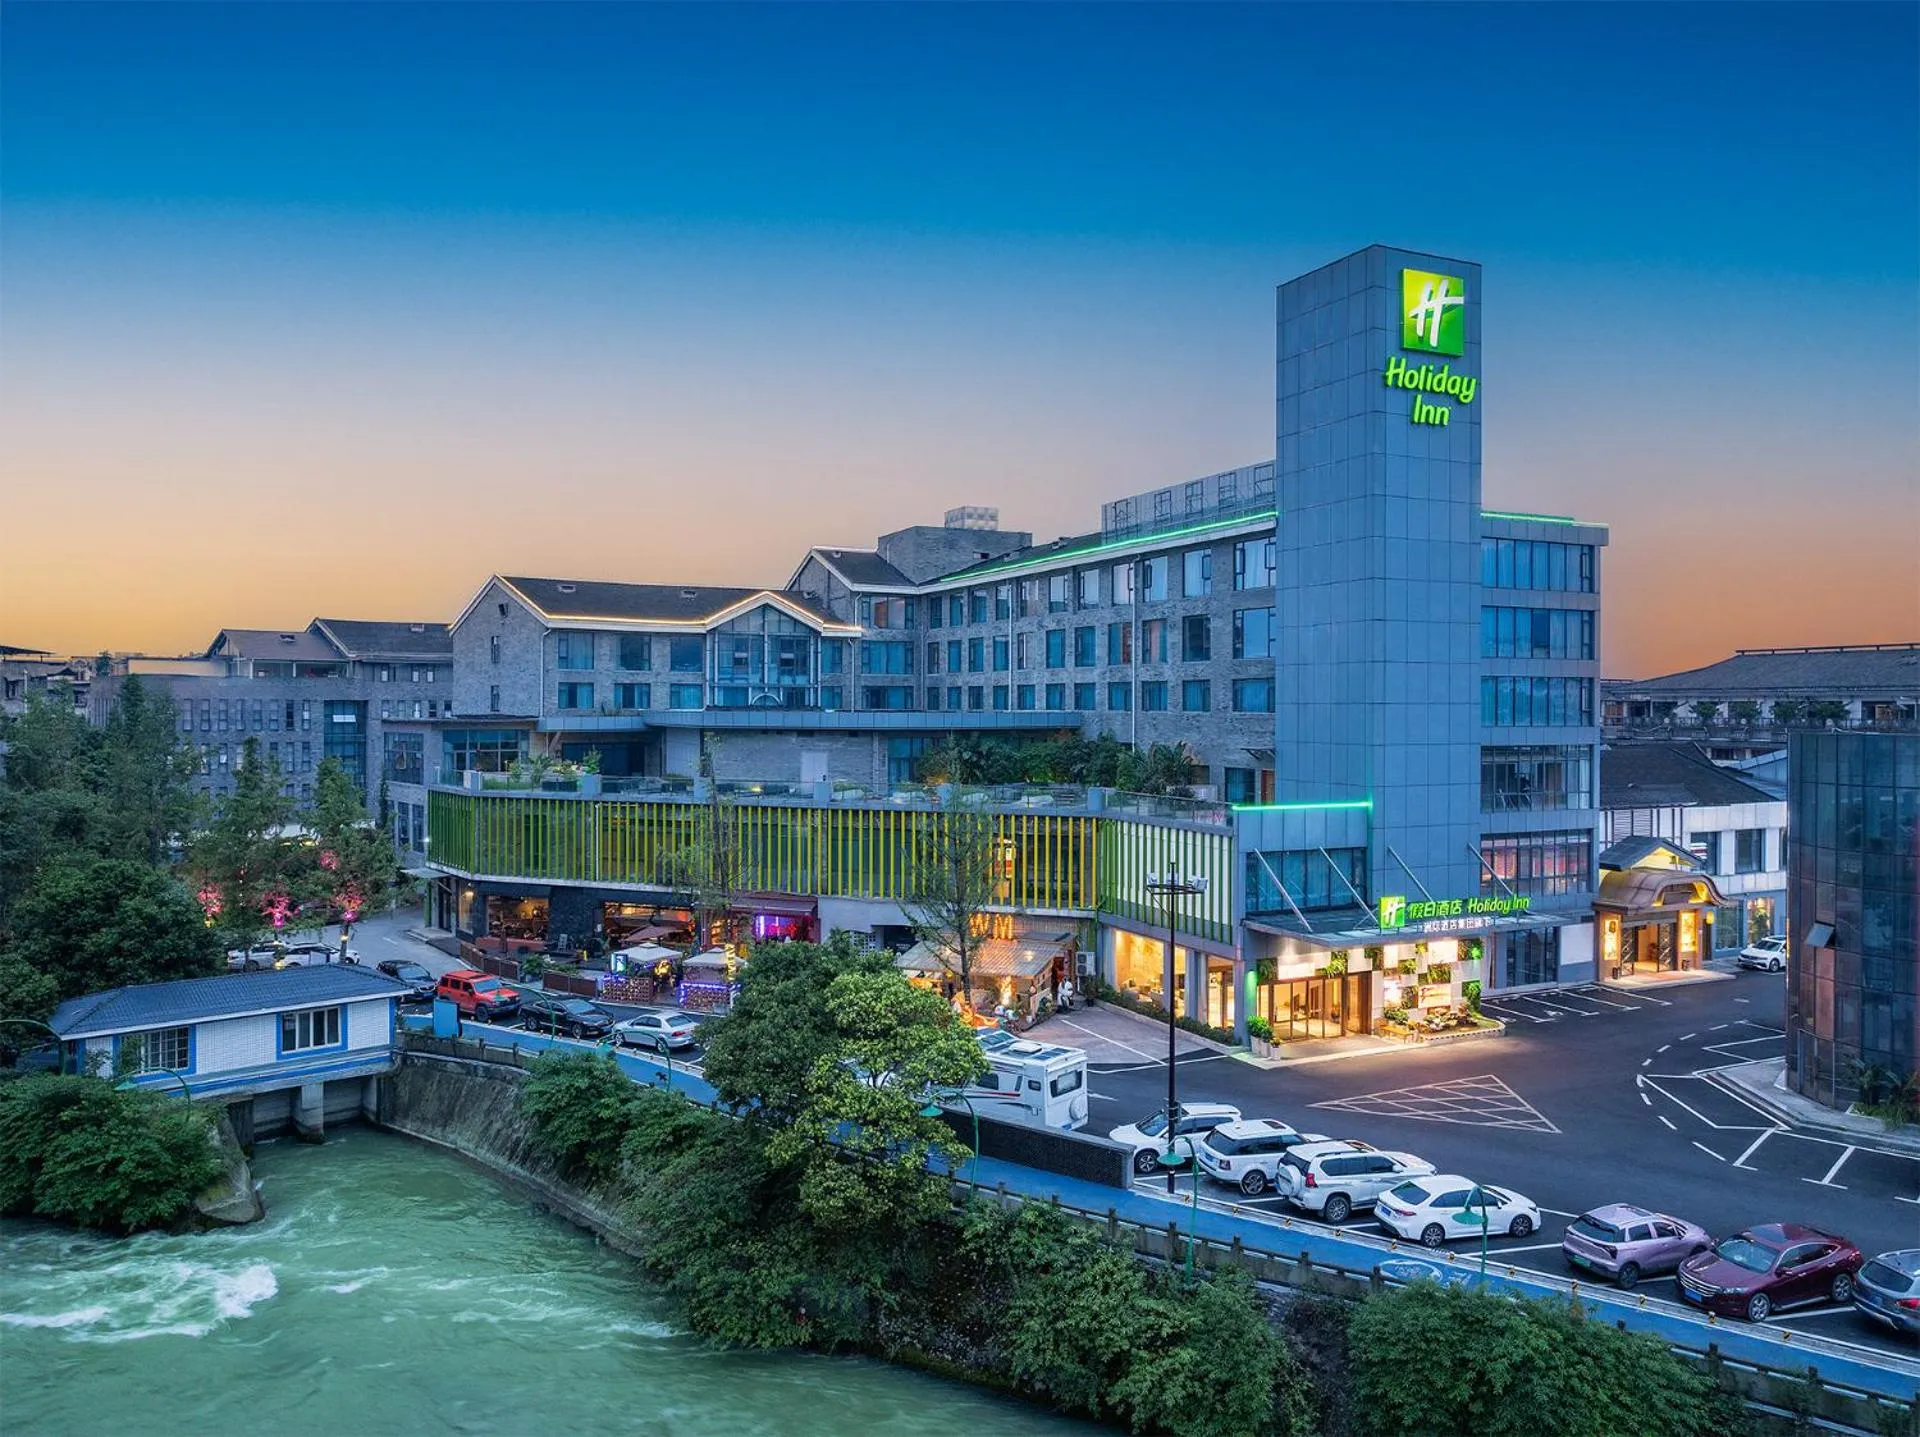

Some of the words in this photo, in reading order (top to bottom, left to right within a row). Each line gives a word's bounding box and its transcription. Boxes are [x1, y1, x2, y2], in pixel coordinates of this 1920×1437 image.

[1385, 356, 1477, 404] Holiday
[1413, 393, 1450, 425] Inn
[1408, 900, 1463, 919] 假日酒店
[1468, 897, 1511, 916] Holiday
[1512, 894, 1530, 911] Inn
